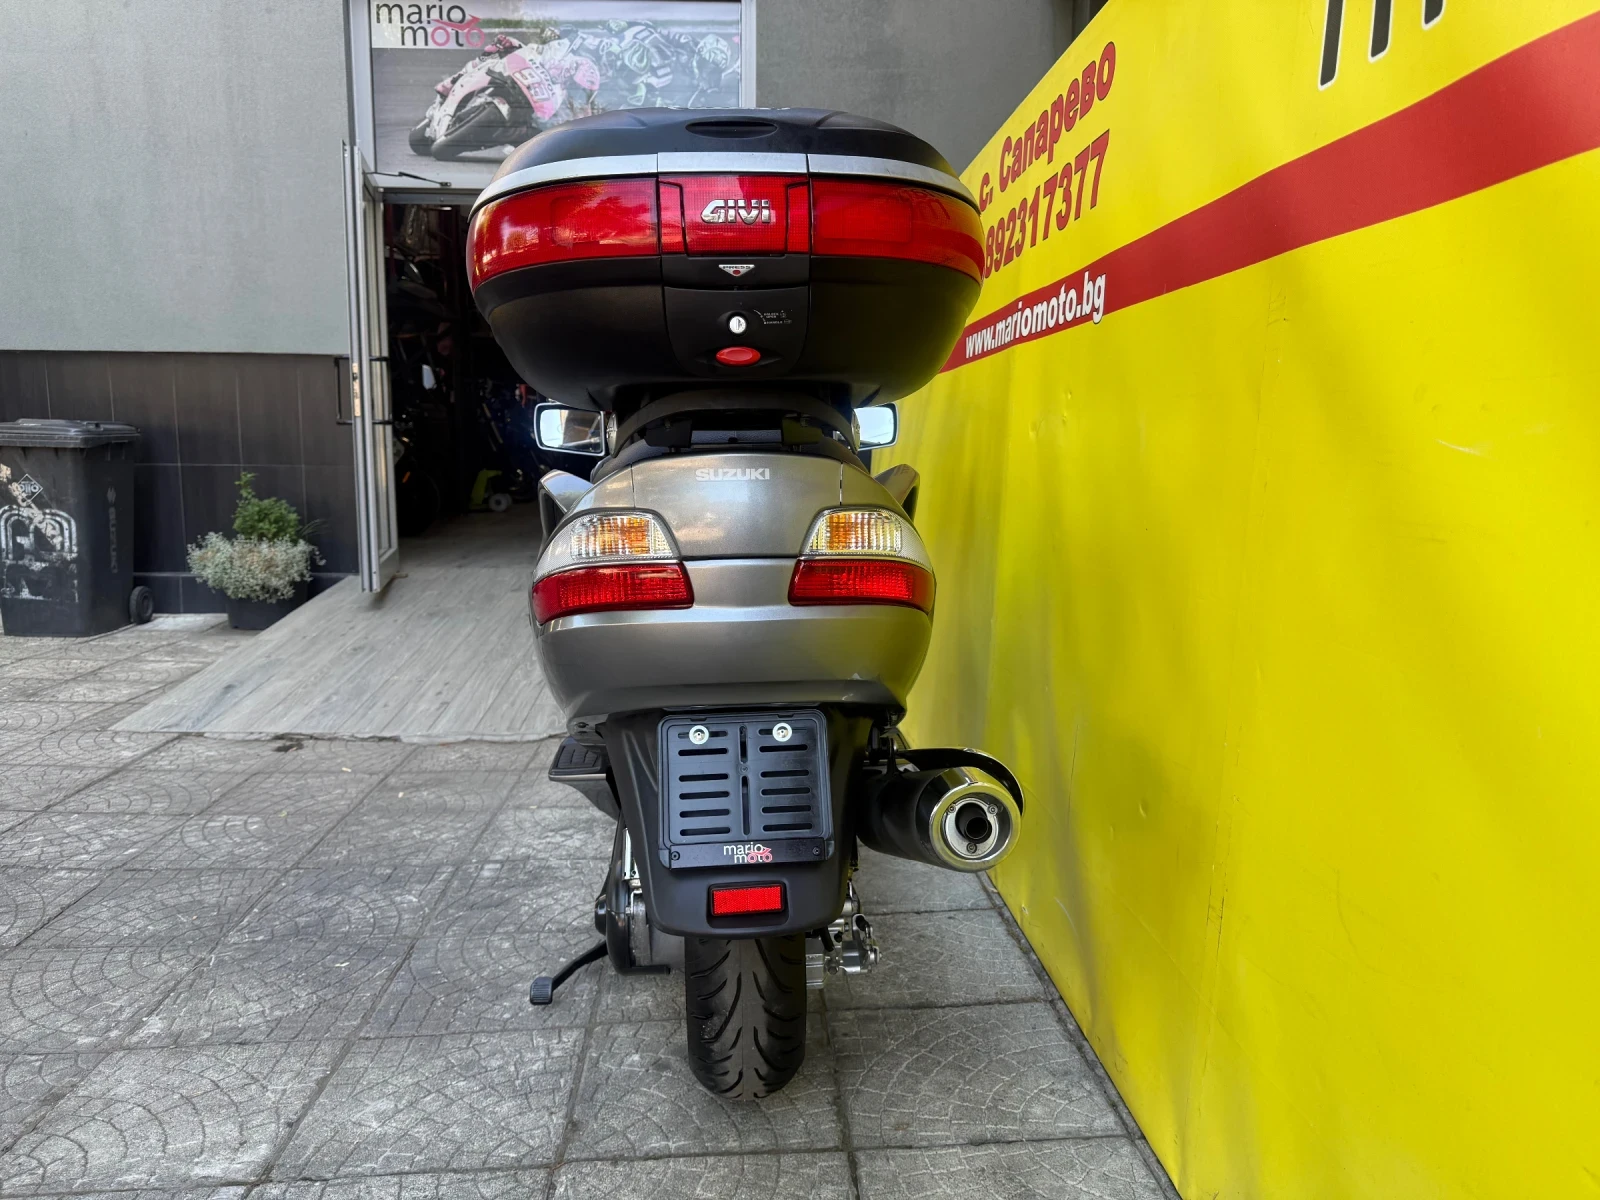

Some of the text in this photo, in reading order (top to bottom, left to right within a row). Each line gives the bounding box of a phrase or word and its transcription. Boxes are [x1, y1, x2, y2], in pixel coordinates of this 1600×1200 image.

[376, 0, 466, 24] mario
[400, 25, 485, 47] moto
[701, 199, 771, 225] GIVI
[981, 129, 1110, 281] 892317377
[965, 271, 1106, 359] www.mariomoto.bg
[695, 468, 770, 481] SUZUKI
[723, 842, 763, 855] mario
[734, 853, 772, 863] moto
